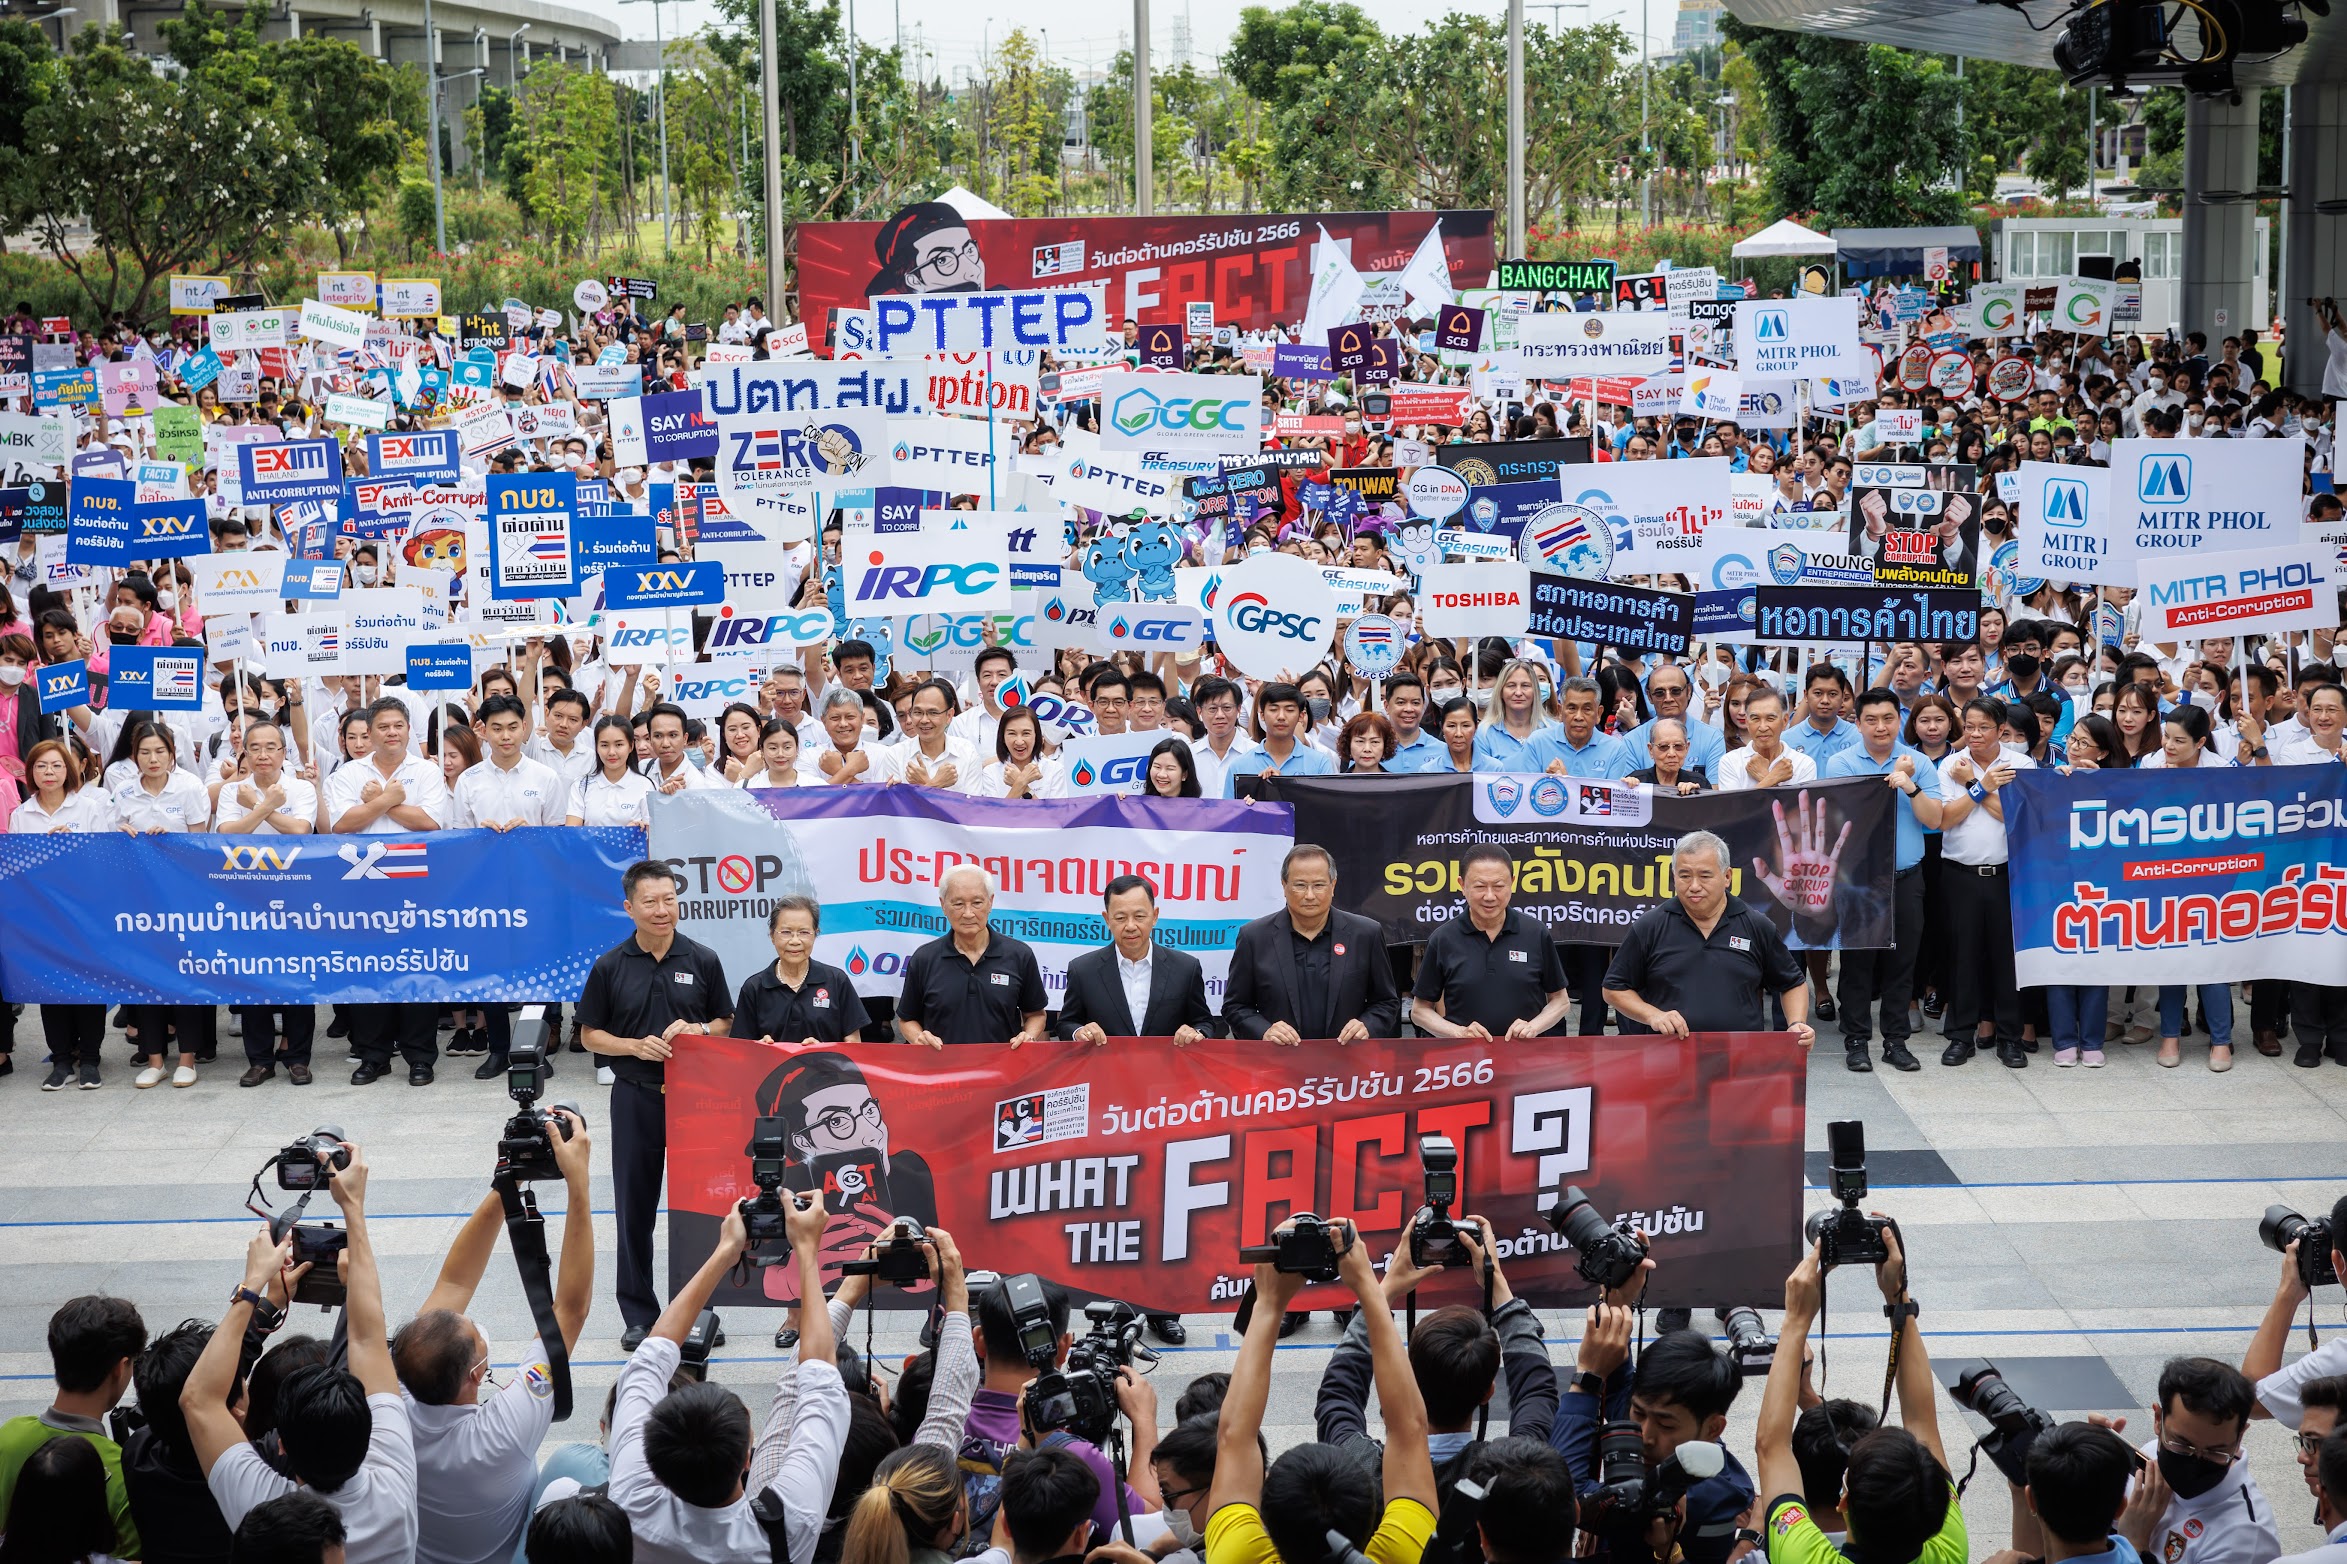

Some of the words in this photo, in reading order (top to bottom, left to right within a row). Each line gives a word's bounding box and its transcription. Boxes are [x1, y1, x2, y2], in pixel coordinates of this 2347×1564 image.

[1090, 226, 1252, 269] วันต่อต้านคอร์รัปชัน
[1256, 221, 1301, 244] 2566
[1501, 265, 1611, 290] BANGCHAK
[1668, 278, 1712, 291] คอร์รัปชัน
[1618, 277, 1664, 300] ACT
[323, 293, 367, 304] Integrity
[262, 319, 280, 329] CP
[306, 312, 361, 336] #ทีมโปร่งใส
[876, 292, 1095, 352] PTTEP
[463, 337, 506, 348] STRONG
[782, 333, 804, 347] SCG
[1445, 335, 1469, 347] SCB
[1523, 335, 1665, 358] กระทรวงพาณิชย์
[1278, 353, 1319, 362] ไทยพาณิชย์
[1756, 345, 1797, 361] MITR
[1800, 344, 1841, 358] PHOL
[1151, 356, 1174, 366] SCB
[1303, 363, 1319, 371] SCB
[1341, 354, 1364, 368] SCB
[1756, 361, 1799, 372] GROUP
[1365, 369, 1389, 380] SCB
[1938, 368, 1965, 376] Together
[57, 381, 94, 396] ภัยโกง
[1843, 378, 1861, 389] Thai
[1845, 385, 1870, 396] Union
[1995, 385, 2027, 394] Corruption
[706, 367, 921, 416] ปตท.สผ.
[1636, 389, 1662, 400] SAY
[1394, 396, 1454, 406] รถไฟฟ้าสายสีแดง
[1709, 394, 1726, 404] Thai
[465, 403, 493, 419] #STOP
[543, 407, 567, 421] หยุด
[1708, 402, 1732, 412] Union
[460, 408, 503, 429] CORRUPTION
[1160, 398, 1252, 431] GGC
[651, 413, 686, 433] SAY
[1277, 417, 1303, 429] SRTET
[617, 436, 640, 445] PTTEP
[652, 435, 665, 444] TO
[665, 428, 718, 443] CORRUPTION
[382, 436, 444, 459] EXIM
[256, 445, 325, 473] EXIM
[384, 457, 420, 466] THAILAND
[912, 445, 997, 468] PTTEP
[1143, 451, 1169, 462] GC
[1141, 460, 1216, 472] TREASURY
[144, 468, 171, 481] FACTS
[258, 470, 299, 481] THAILAND
[733, 468, 811, 483] TOLERANCE
[1087, 465, 1166, 498] PTTEP
[1227, 469, 1266, 490] ZERO
[755, 480, 813, 490] ไม่ทนต่อการทุจริต
[1413, 484, 1428, 493] CG
[1430, 484, 1439, 493] in
[1441, 484, 1463, 494] DNA
[246, 484, 341, 501] ANTI-CORRUPTION
[500, 488, 565, 510] กบข.
[1412, 493, 1440, 503] Together
[82, 495, 122, 511] กบข.
[756, 498, 807, 515] PTTEP
[881, 504, 916, 520] SAY
[1535, 505, 1579, 525] CHAMBERS
[73, 515, 129, 531] ร่วมต่อต้าน
[502, 516, 565, 533] ต่อต้าน
[881, 523, 893, 531] TO
[1633, 515, 1664, 525] มิตรผล
[2136, 511, 2201, 530] MITR
[2206, 511, 2272, 530] PHOL
[1438, 532, 1463, 543] GC
[1637, 523, 1675, 539] ร่วมใจ
[75, 536, 124, 549] คอร์รัปชัน
[592, 540, 650, 554] ร่วมต่อต้าน
[1885, 530, 1938, 555] STOP
[2042, 531, 2097, 554] MITR
[2135, 533, 2203, 548] GROUP
[1811, 552, 1875, 572] YOUNG
[1883, 551, 1937, 565] CORRUPTION
[2041, 552, 2098, 571] GROUP
[504, 562, 567, 574] คอร์รัปชัน
[1322, 569, 1346, 580] GC
[286, 573, 310, 584] กบข.
[723, 572, 775, 588] PTTEP
[1801, 577, 1826, 586] CHAMBER
[1807, 569, 1873, 582] ENTREPRENEUR
[2149, 574, 2228, 607] MITR
[2239, 561, 2326, 595] PHOL
[1432, 591, 1521, 608] TOSHIBA
[1535, 580, 1680, 622] สภาหอการค้า
[1761, 593, 1977, 640] หอการค้าไทย
[2174, 594, 2306, 625] Anti-Corruption
[354, 613, 416, 629] ร่วมต่อต้าน
[1236, 603, 1322, 643] GPSC
[209, 631, 226, 641] กบข.
[307, 625, 338, 636] ต่อต้าน
[1133, 619, 1192, 642] GC
[271, 640, 302, 653] กบข.
[156, 660, 195, 670] ต่อต้าน
[409, 657, 433, 667] กบข.
[435, 656, 468, 667] ร่วมต่อต้าน
[424, 669, 454, 678] คอร์รัปชัน
[1355, 669, 1394, 680] JFCCT
[156, 686, 194, 694] คอร์รัปชัน
[208, 716, 221, 724] GPF
[523, 788, 540, 797] GPF
[1581, 787, 1610, 799] ACT
[165, 806, 182, 815] GPF
[620, 802, 636, 811] GPF
[66, 821, 81, 830] GPF
[1791, 863, 1831, 879] STOP
[2131, 856, 2259, 879] Anti-Corruption
[208, 871, 312, 883] กองทุนบำเหน็จบำนาญข้าราชการ
[1783, 878, 1829, 892] CORRUP
[115, 898, 529, 941] กองทุนบำเหน็จบำนาญข้าราชการ
[177, 948, 470, 982] ต่อต้านการทุจริตคอร์รัปชัน
[1046, 1095, 1086, 1110] คอร์รัปชัน
[1101, 1064, 1404, 1136] วันต่อต้านคอร์รัปชัน
[1412, 1058, 1494, 1095] 2566
[1000, 1097, 1044, 1121] ACT
[1046, 1116, 1085, 1127] ANTI-CORRUPTION
[1046, 1122, 1085, 1134] ORGANIZATION
[1055, 1129, 1084, 1138] THAILAND
[990, 1154, 1139, 1220] WHAT
[1161, 1099, 1492, 1264] FACT
[1064, 1220, 1140, 1264] THE
[1889, 1330, 1900, 1365] Nikon
